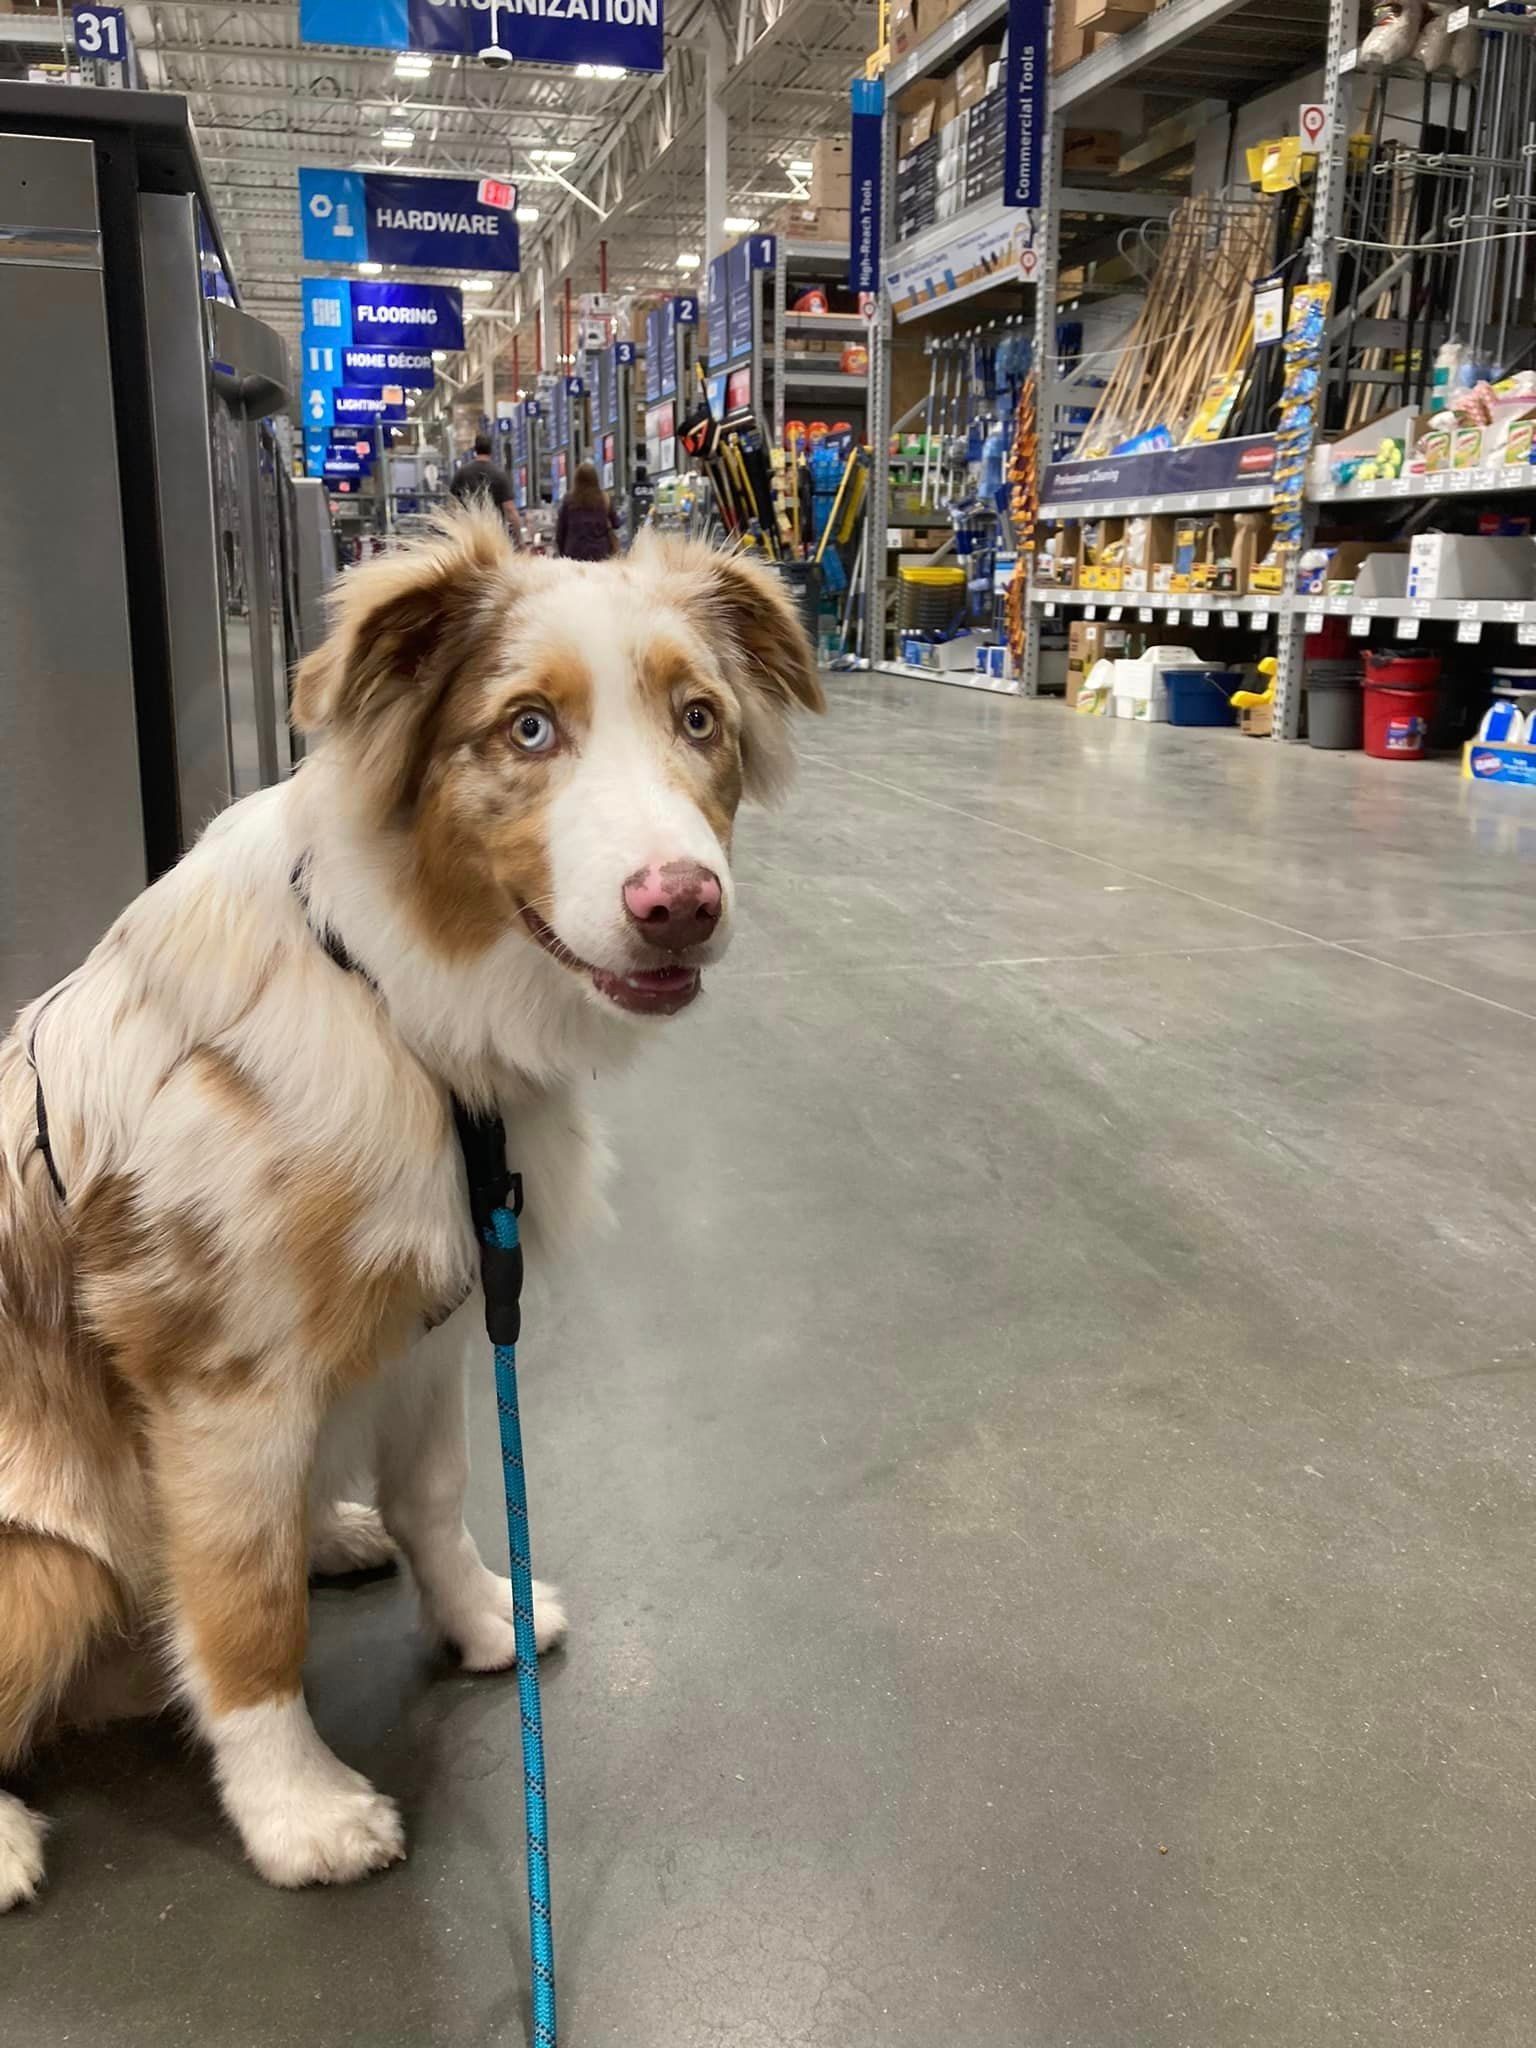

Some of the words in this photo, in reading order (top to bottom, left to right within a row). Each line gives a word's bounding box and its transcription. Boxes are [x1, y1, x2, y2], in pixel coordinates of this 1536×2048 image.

[428, 0, 658, 26] NIZATION
[77, 12, 119, 54] 31
[1019, 45, 1035, 93] Tools
[1015, 98, 1033, 199] Commercial
[860, 180, 873, 213] Tools
[376, 207, 499, 236] HARDWARE
[760, 239, 772, 263] 1
[860, 215, 873, 286] High-Reach
[357, 304, 438, 325] FLOORING
[680, 301, 693, 320] 2
[346, 352, 386, 368] HOME
[387, 351, 432, 369] DÉCOR
[619, 344, 632, 362] 3
[569, 379, 580, 393] 4
[336, 398, 387, 412] LIGHTING
[527, 401, 537, 414] 5
[501, 420, 509, 431] 6
